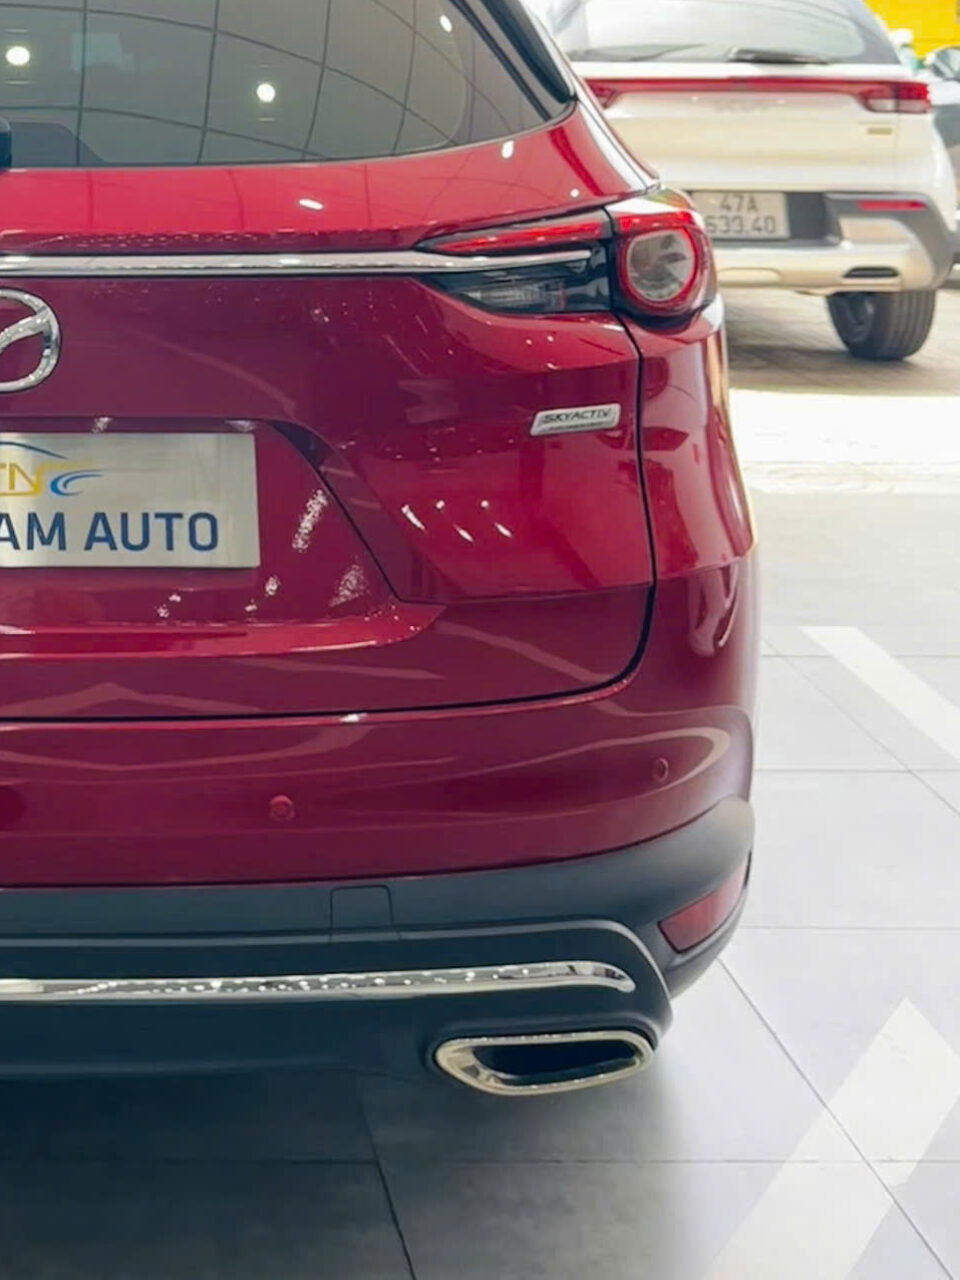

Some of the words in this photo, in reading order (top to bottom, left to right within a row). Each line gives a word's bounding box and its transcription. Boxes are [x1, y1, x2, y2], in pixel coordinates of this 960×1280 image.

[720, 194, 759, 213] 47A
[542, 408, 612, 424] SKYACTIV
[83, 511, 220, 552] AUTO
